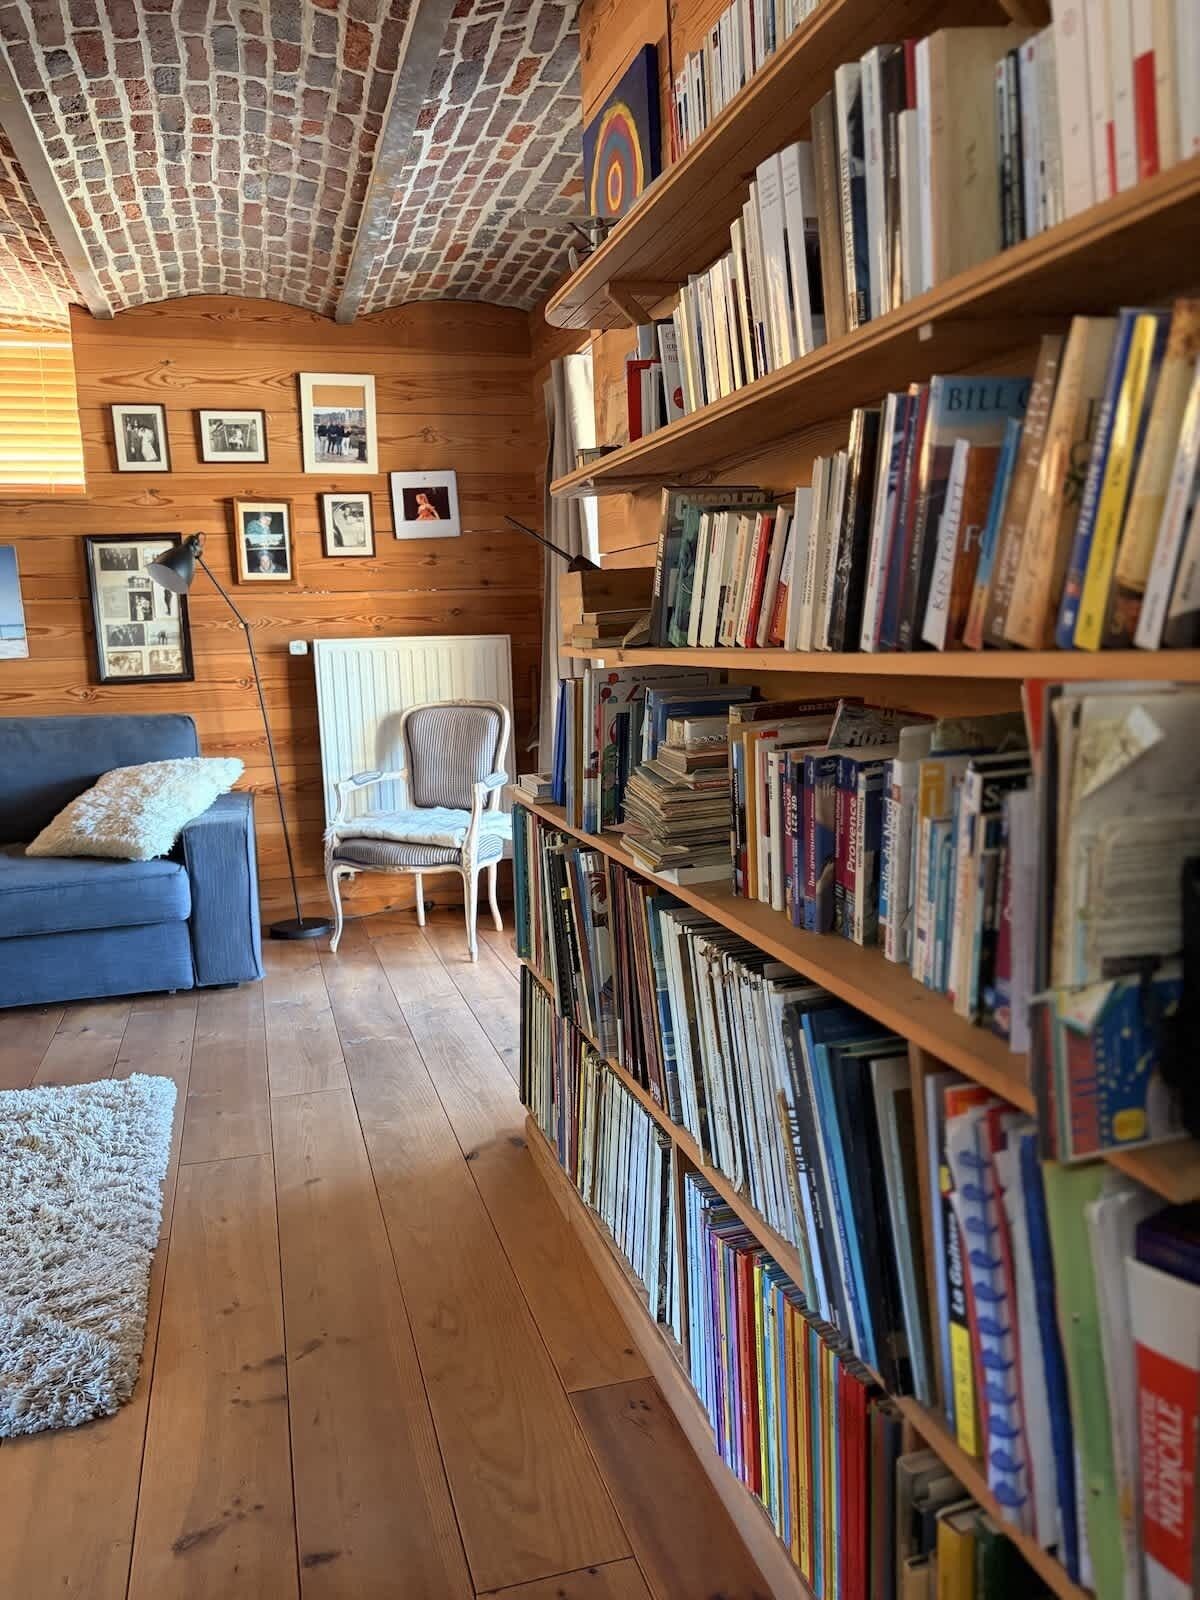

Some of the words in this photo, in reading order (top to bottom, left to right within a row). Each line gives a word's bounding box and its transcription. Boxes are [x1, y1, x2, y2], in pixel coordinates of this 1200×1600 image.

[947, 386, 1009, 411] BILL
[1080, 463, 1099, 536] NORTH
[785, 786, 793, 836] Kenya
[883, 797, 894, 836] Nord
[847, 797, 856, 873] Provence
[882, 840, 892, 861] du
